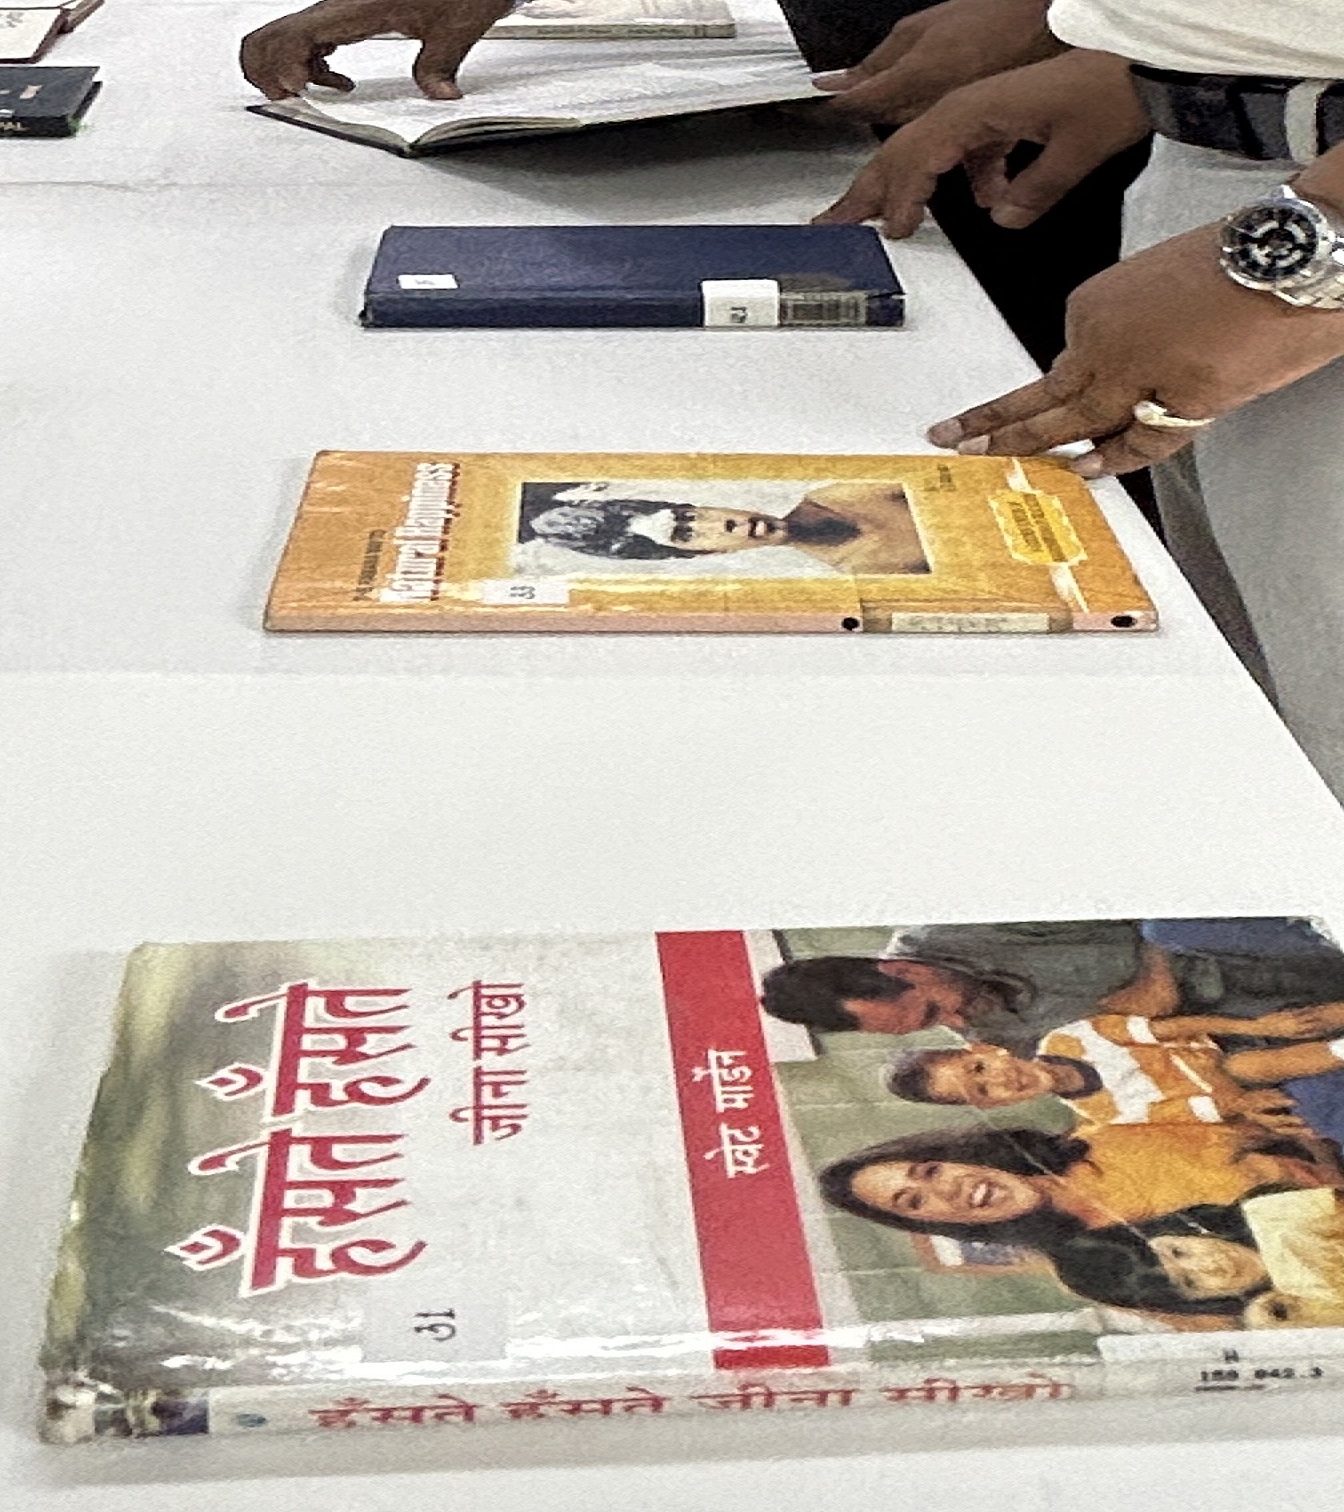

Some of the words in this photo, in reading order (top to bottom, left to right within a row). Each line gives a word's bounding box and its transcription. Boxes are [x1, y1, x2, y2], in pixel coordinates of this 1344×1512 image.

[394, 461, 461, 539] Happiness
[379, 538, 449, 603] Natural
[197, 977, 429, 1121] हँसते
[449, 979, 530, 1060] सीखो
[449, 1066, 530, 1146] जीना
[168, 1127, 427, 1296] हँसते
[308, 1392, 478, 1429] हँसते
[500, 1386, 669, 1424] हँसते
[689, 1381, 861, 1413] जीना
[881, 1371, 1078, 1404] सीखो
